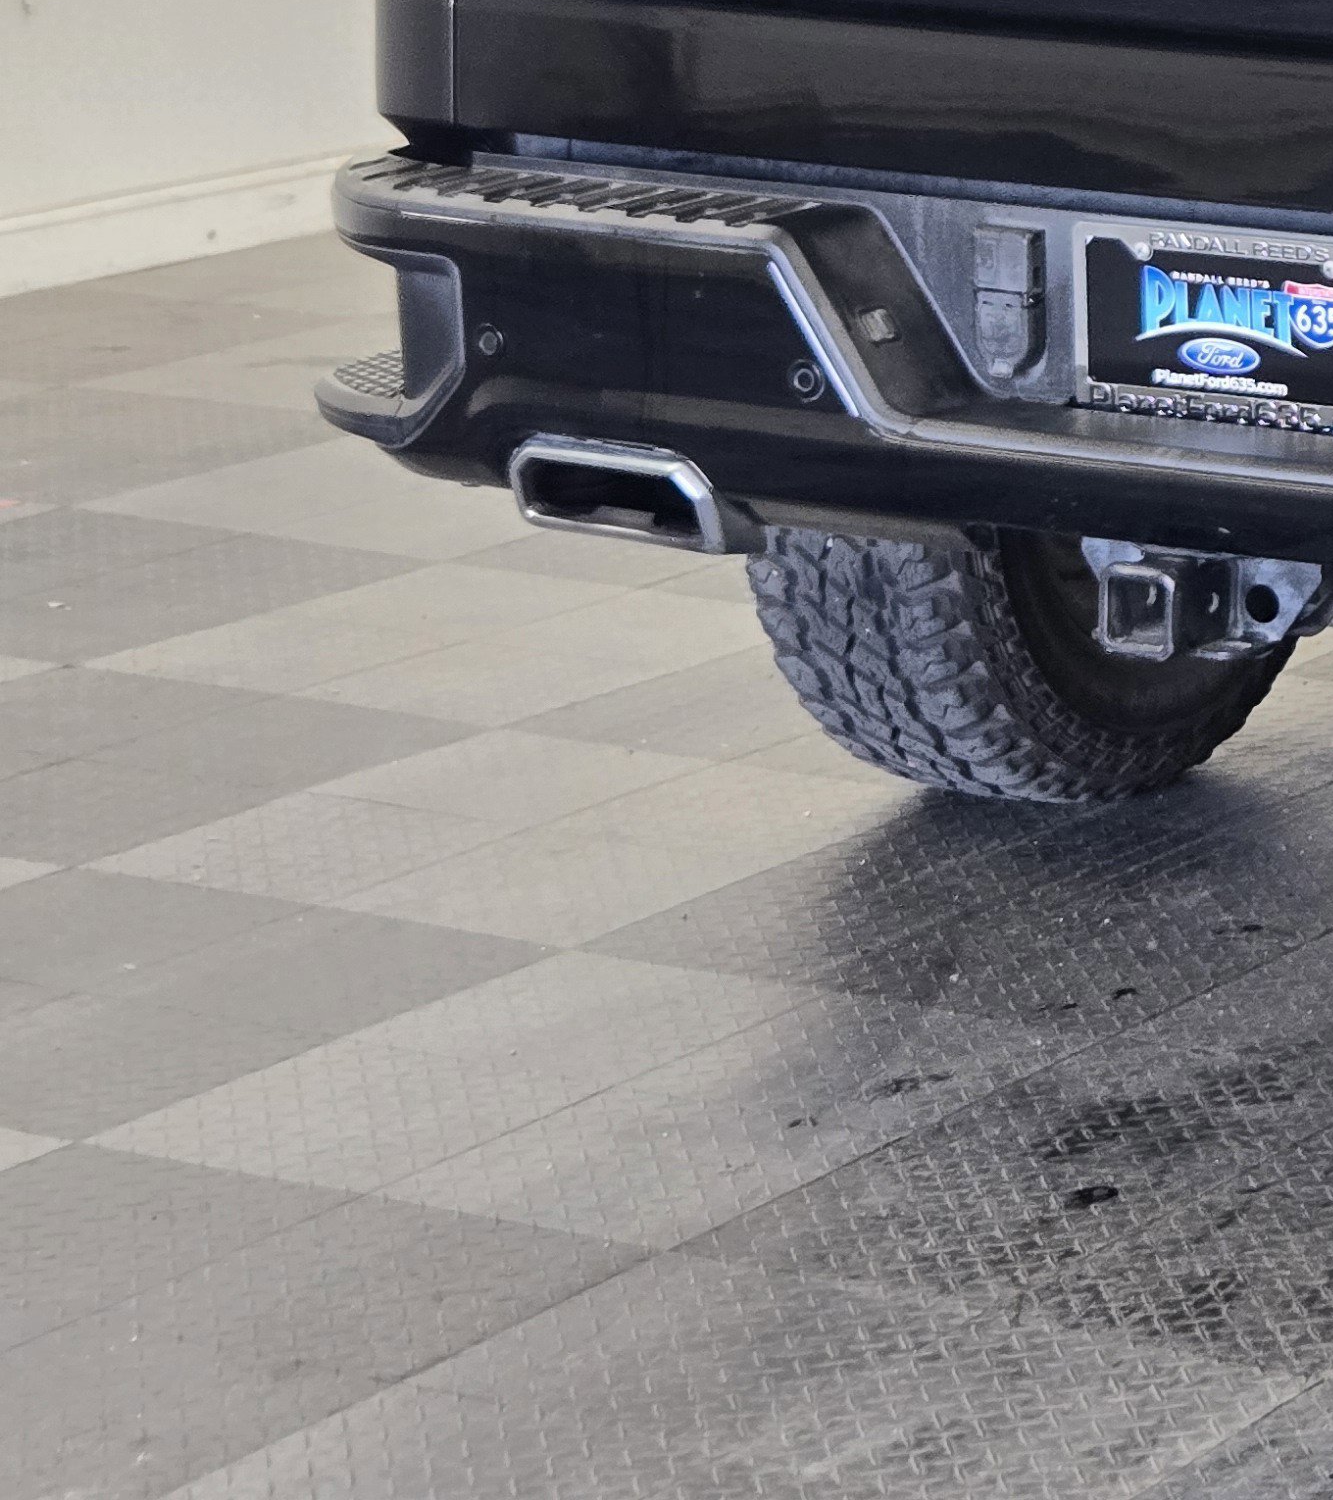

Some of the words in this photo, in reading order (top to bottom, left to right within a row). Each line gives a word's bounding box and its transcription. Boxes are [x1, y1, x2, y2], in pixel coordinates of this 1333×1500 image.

[1149, 231, 1246, 255] RANDALL
[1252, 240, 1330, 263] REED'S
[1138, 264, 1294, 346] PLANET
[1196, 342, 1245, 369] Ford
[1151, 367, 1289, 398] PlanetFord635.com
